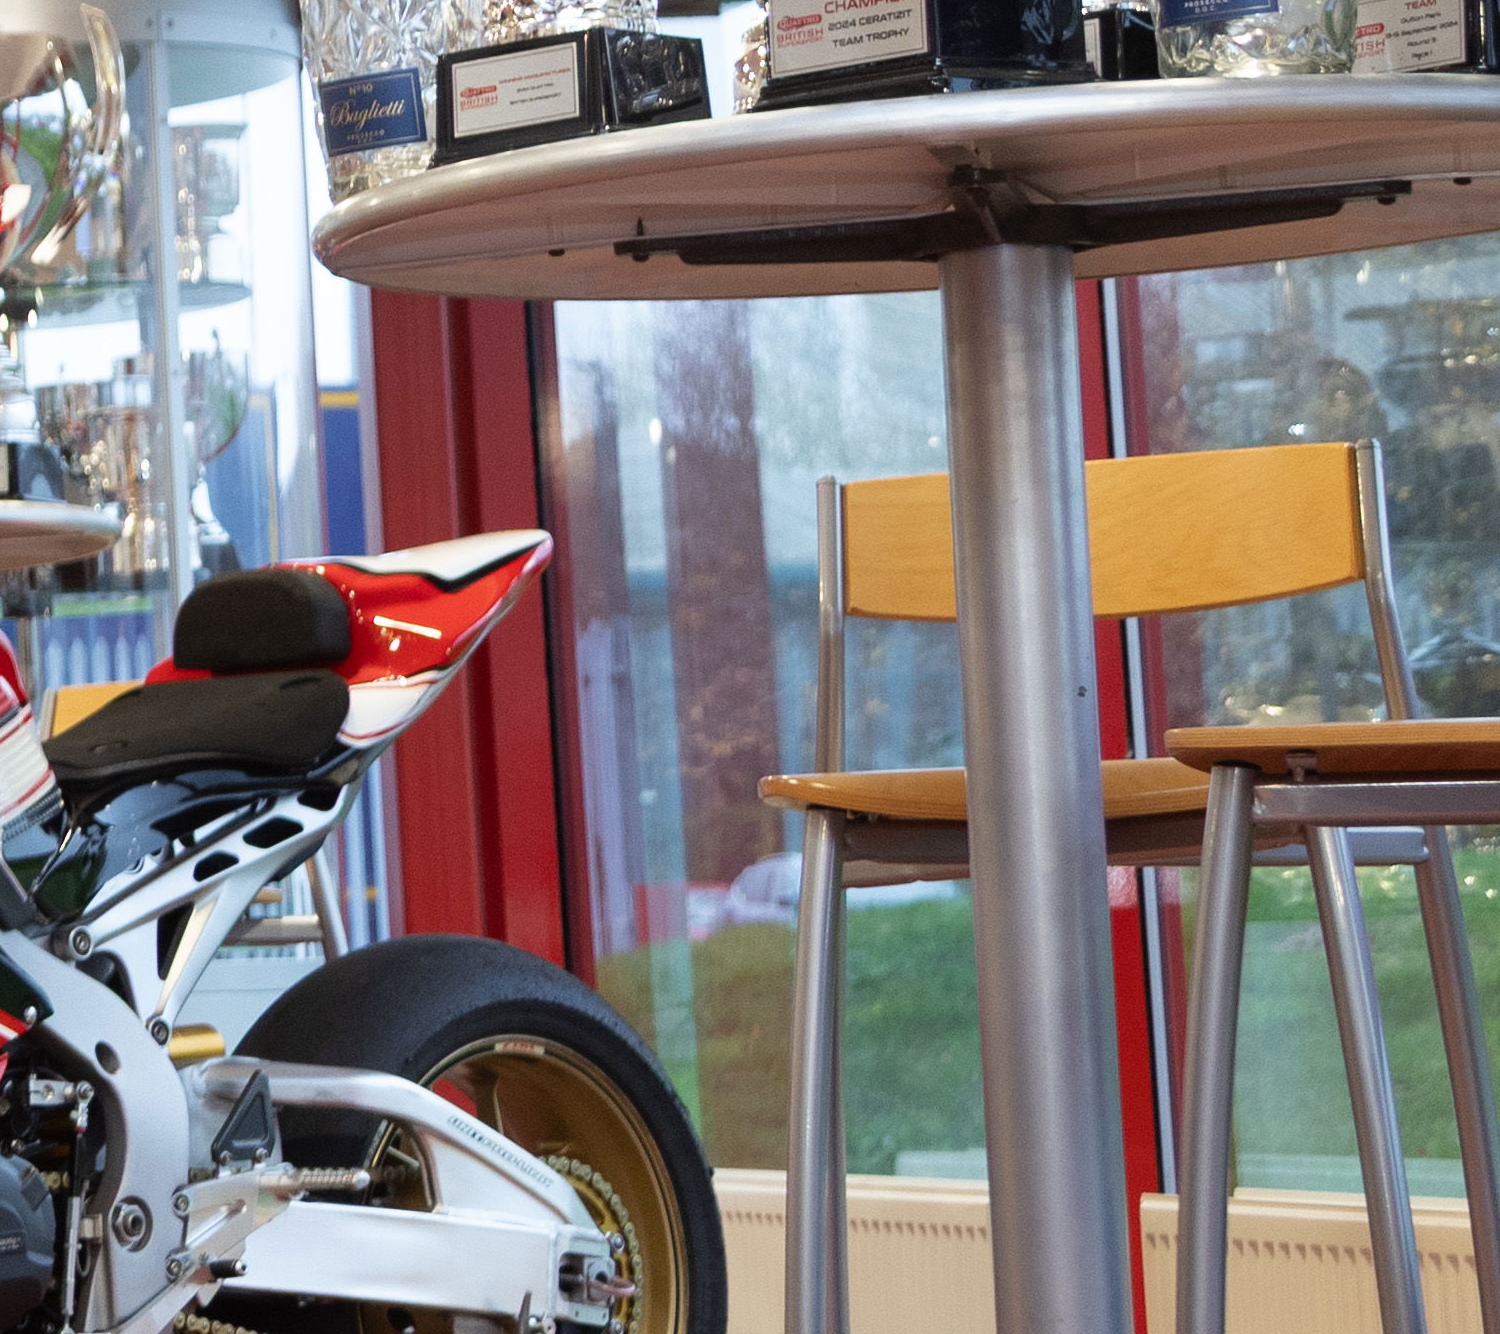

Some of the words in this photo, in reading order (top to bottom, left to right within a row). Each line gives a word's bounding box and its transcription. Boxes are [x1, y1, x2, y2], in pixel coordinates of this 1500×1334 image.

[828, 18, 857, 31] 2024
[859, 9, 912, 26] CERATIZIT
[776, 27, 824, 43] BRITISH
[832, 35, 864, 48] TEAM
[867, 27, 910, 43] TROPHY
[330, 99, 405, 132] Baglietti
